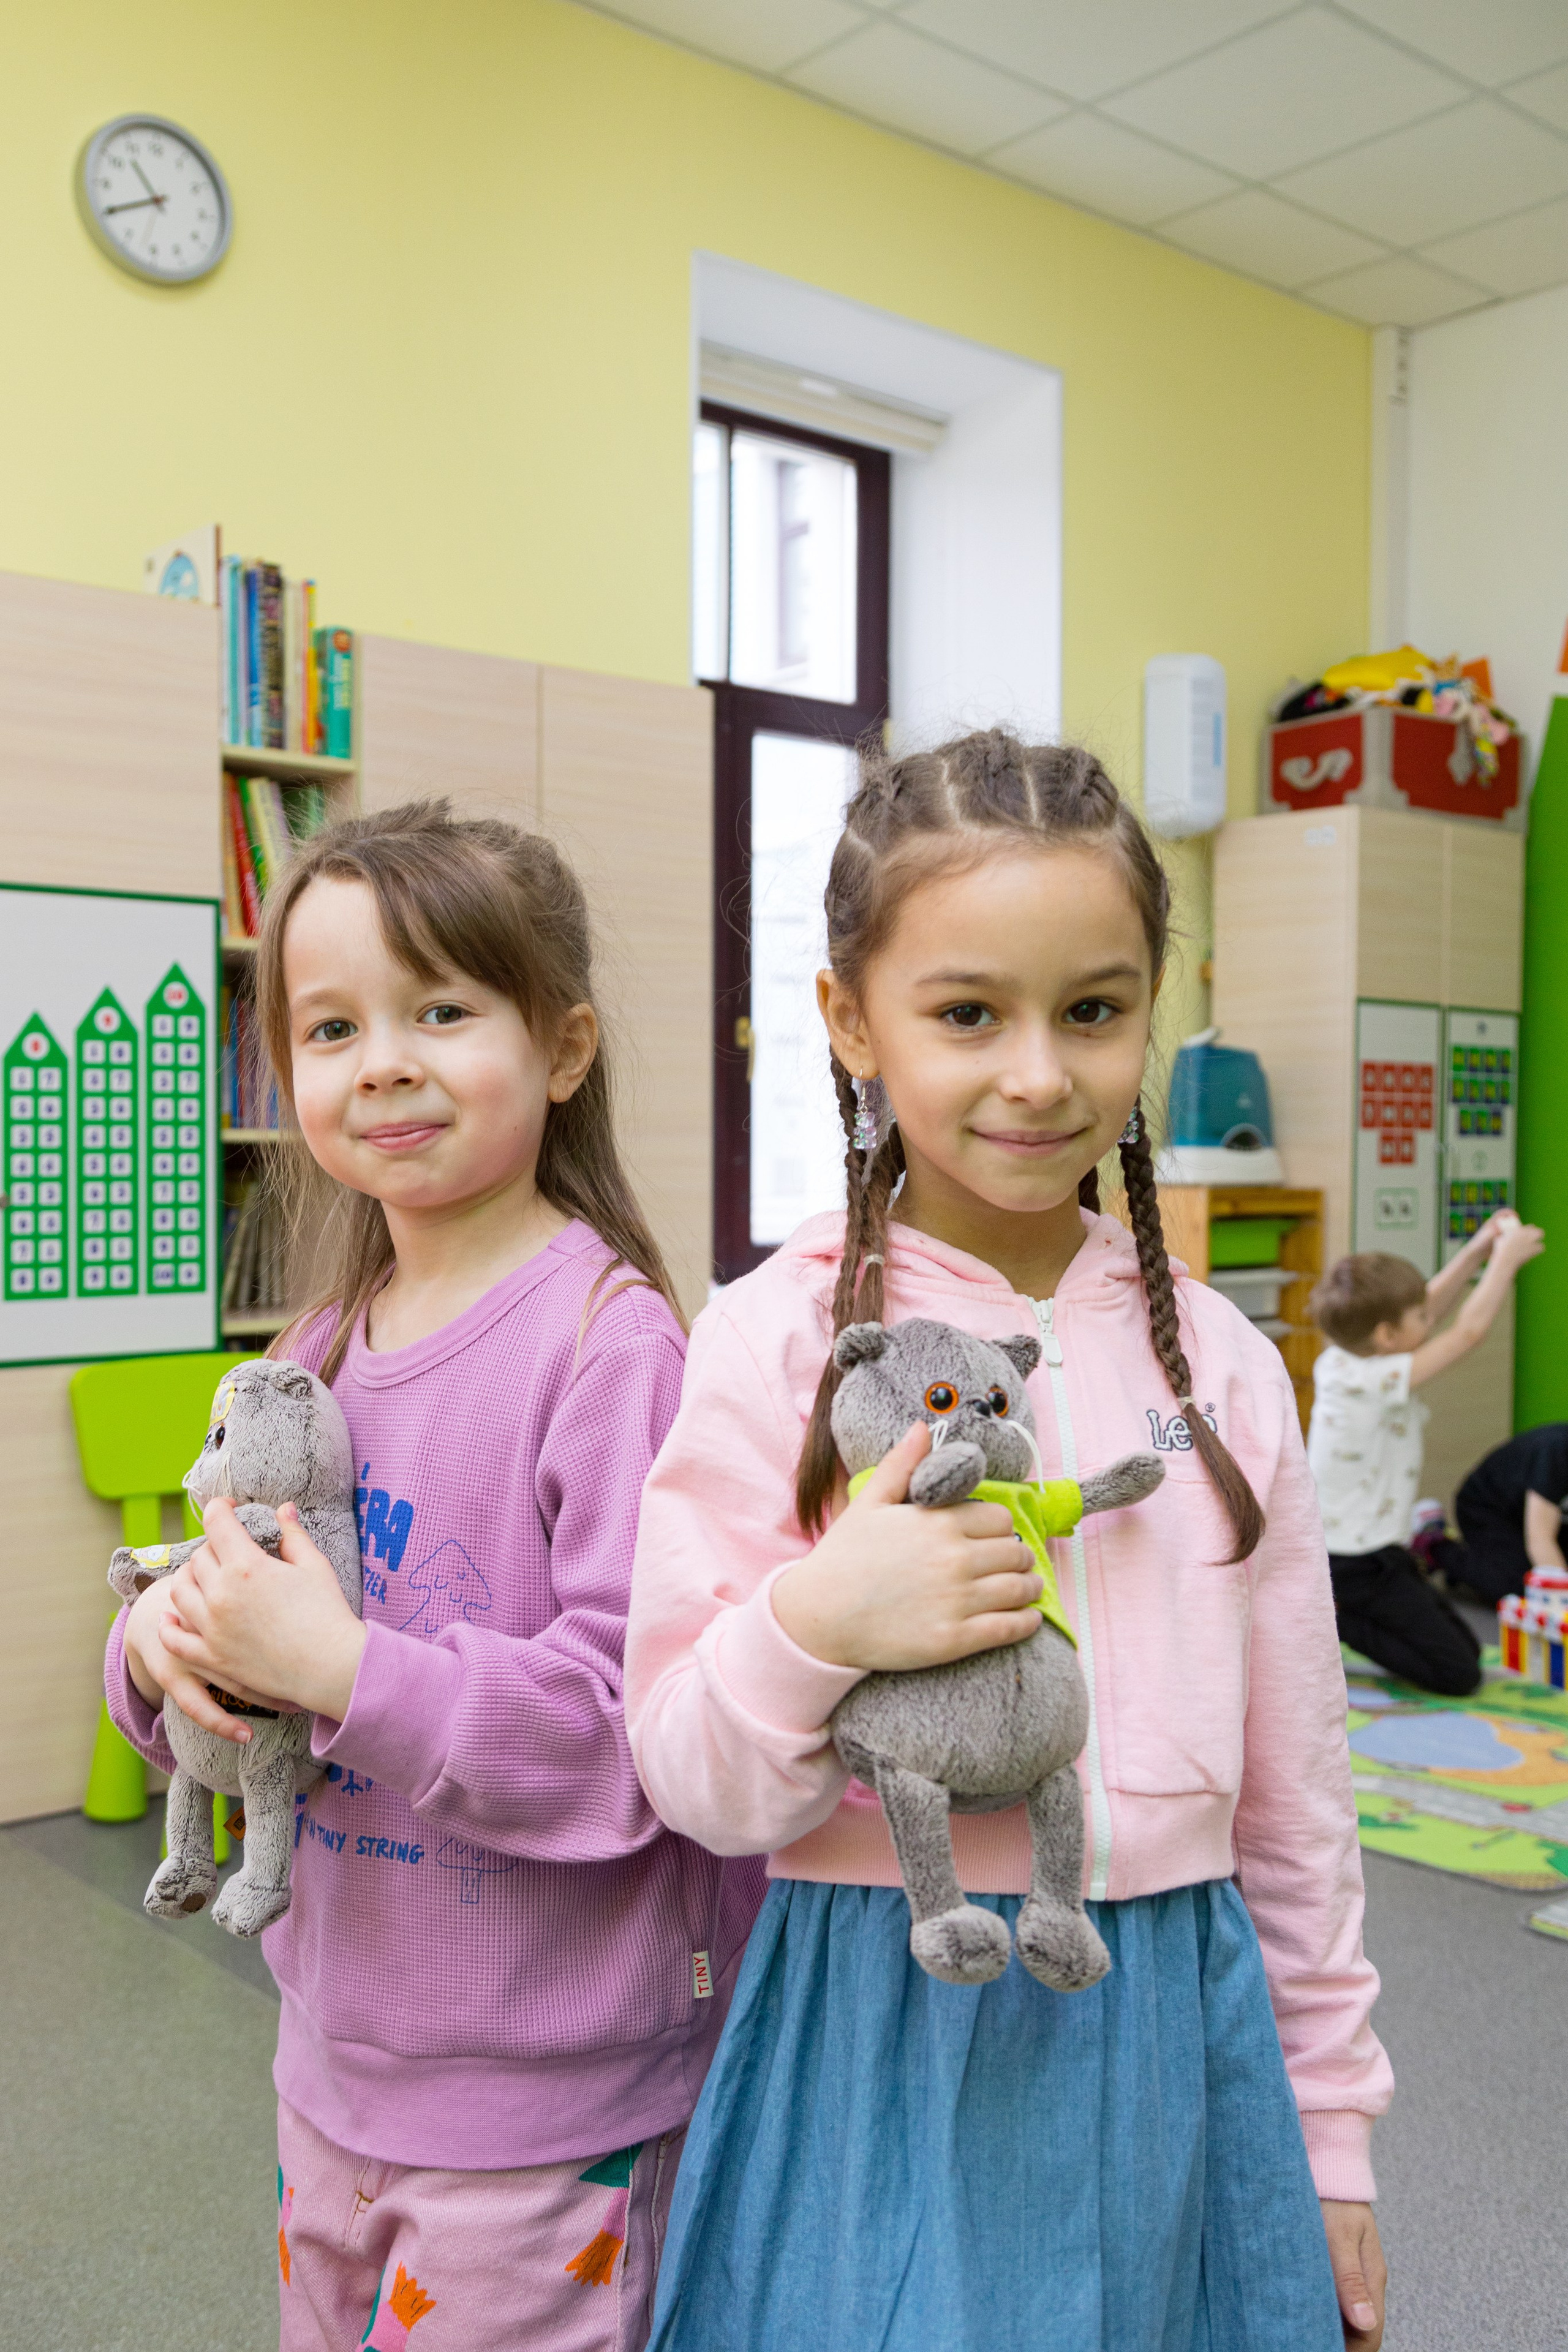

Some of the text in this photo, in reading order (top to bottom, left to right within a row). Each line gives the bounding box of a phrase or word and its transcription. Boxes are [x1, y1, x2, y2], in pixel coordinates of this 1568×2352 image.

[317, 1825, 347, 1853] TINY
[356, 1835, 425, 1864] STRING
[693, 1956, 709, 1994] TINY
